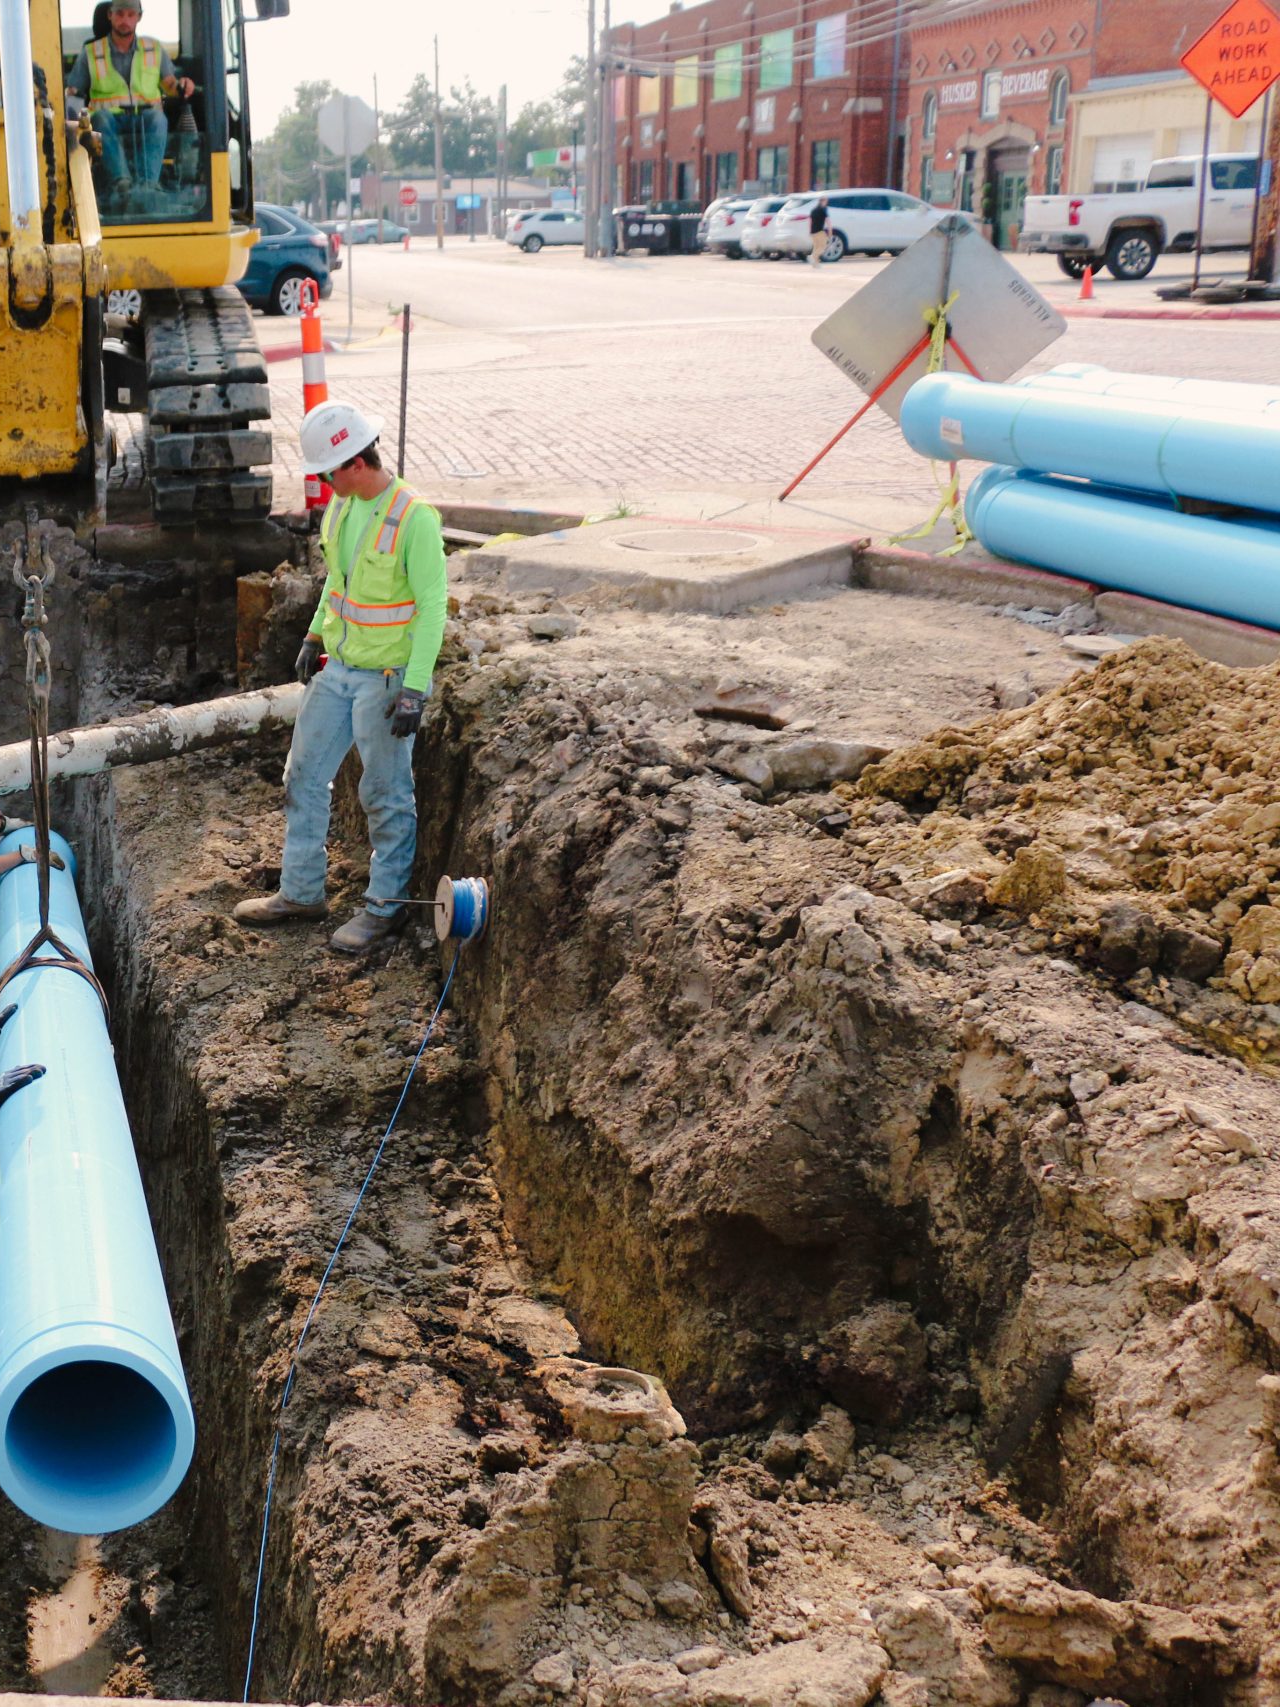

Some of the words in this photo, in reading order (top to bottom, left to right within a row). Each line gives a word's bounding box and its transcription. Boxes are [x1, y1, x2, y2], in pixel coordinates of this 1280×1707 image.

[1221, 19, 1270, 38] ROAD
[1219, 42, 1268, 61] WORK
[941, 80, 978, 104] HUSKER
[1001, 68, 1049, 96] BEVERAGE
[1211, 66, 1272, 86] AHEAD
[827, 346, 845, 361] ALL
[842, 359, 871, 386] ROADS
